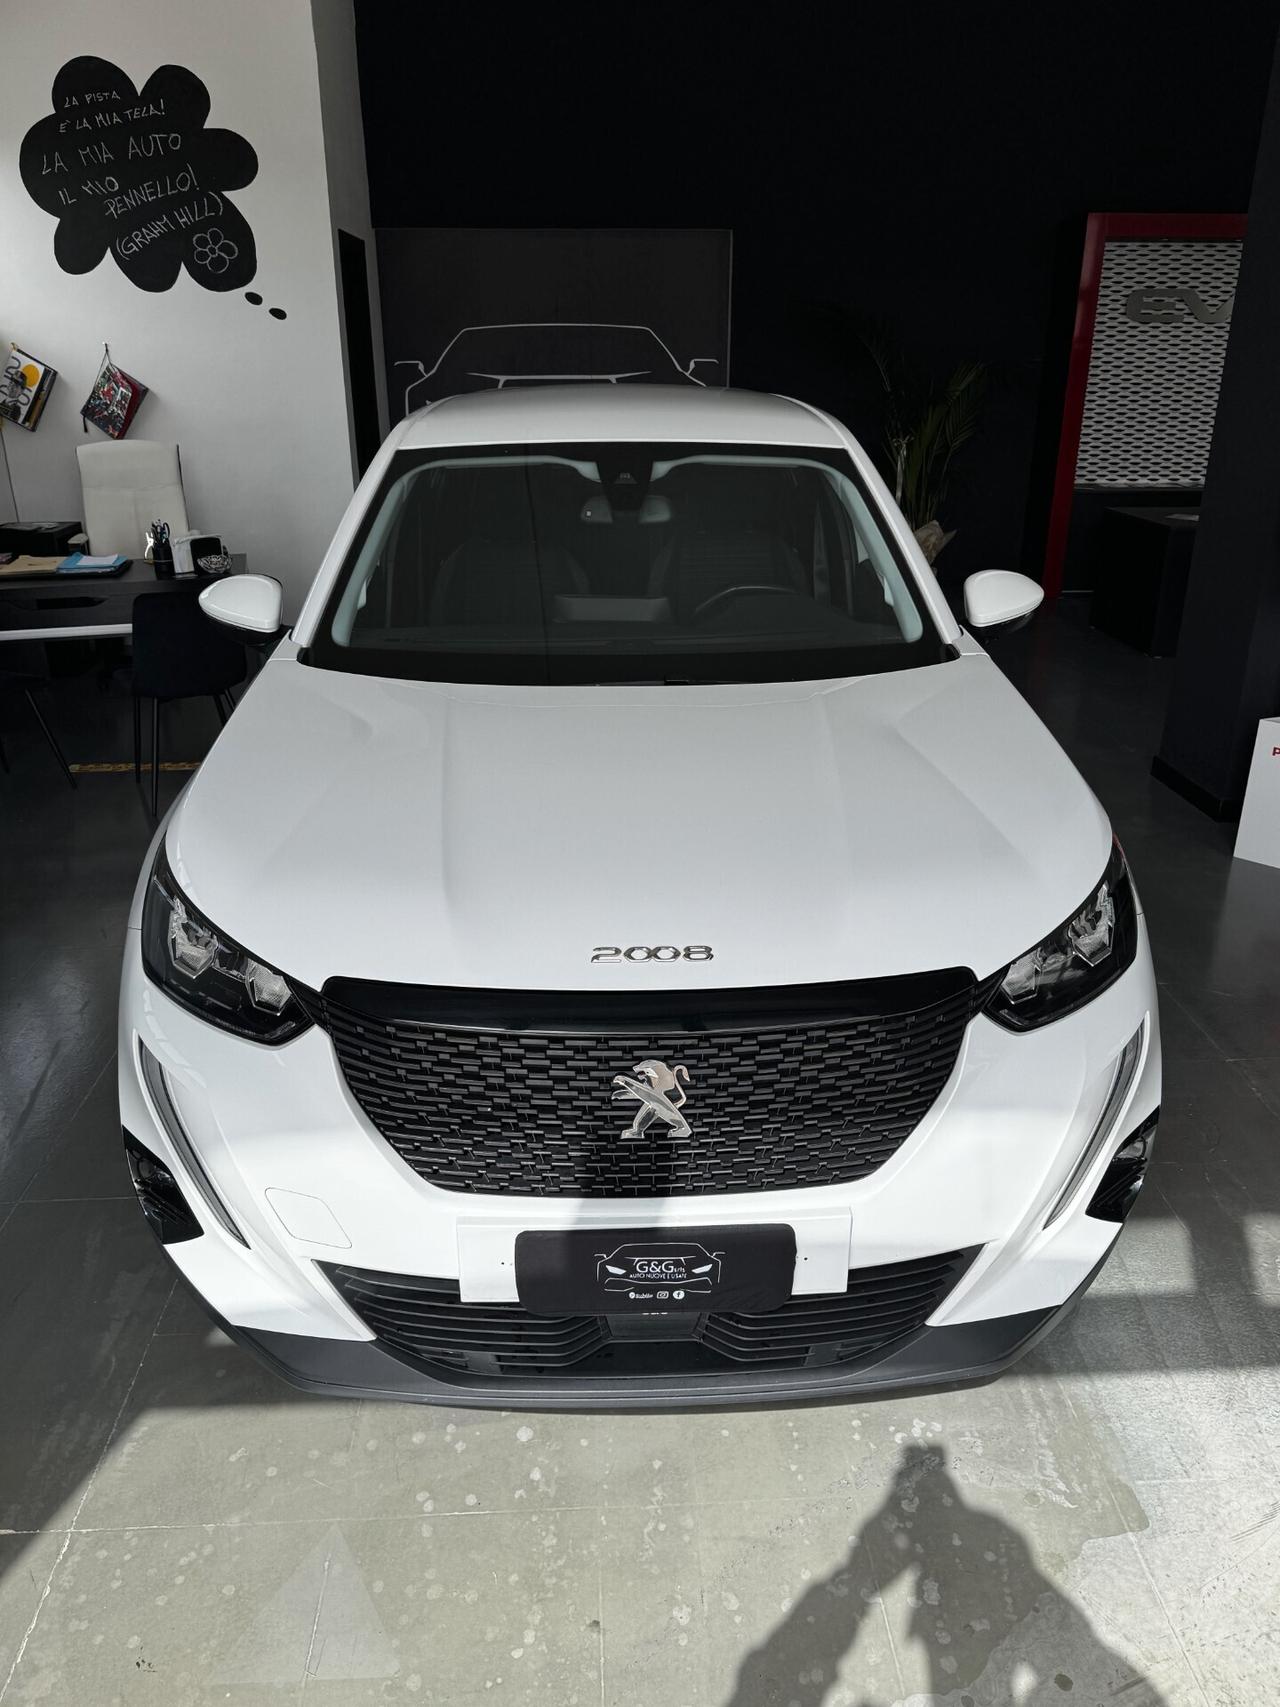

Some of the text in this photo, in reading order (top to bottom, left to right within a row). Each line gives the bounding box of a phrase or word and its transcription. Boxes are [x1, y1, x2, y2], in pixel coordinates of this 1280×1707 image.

[64, 90, 121, 108] LA PISTA
[76, 117, 92, 130] LA
[95, 112, 122, 128] MIA
[123, 99, 166, 122] TELA!
[42, 133, 182, 175] LA MIA AUTO
[58, 176, 119, 206] IL MIO
[105, 163, 200, 219] PENNELLO!
[173, 191, 223, 229] HILL)
[591, 945, 714, 963] 2008
